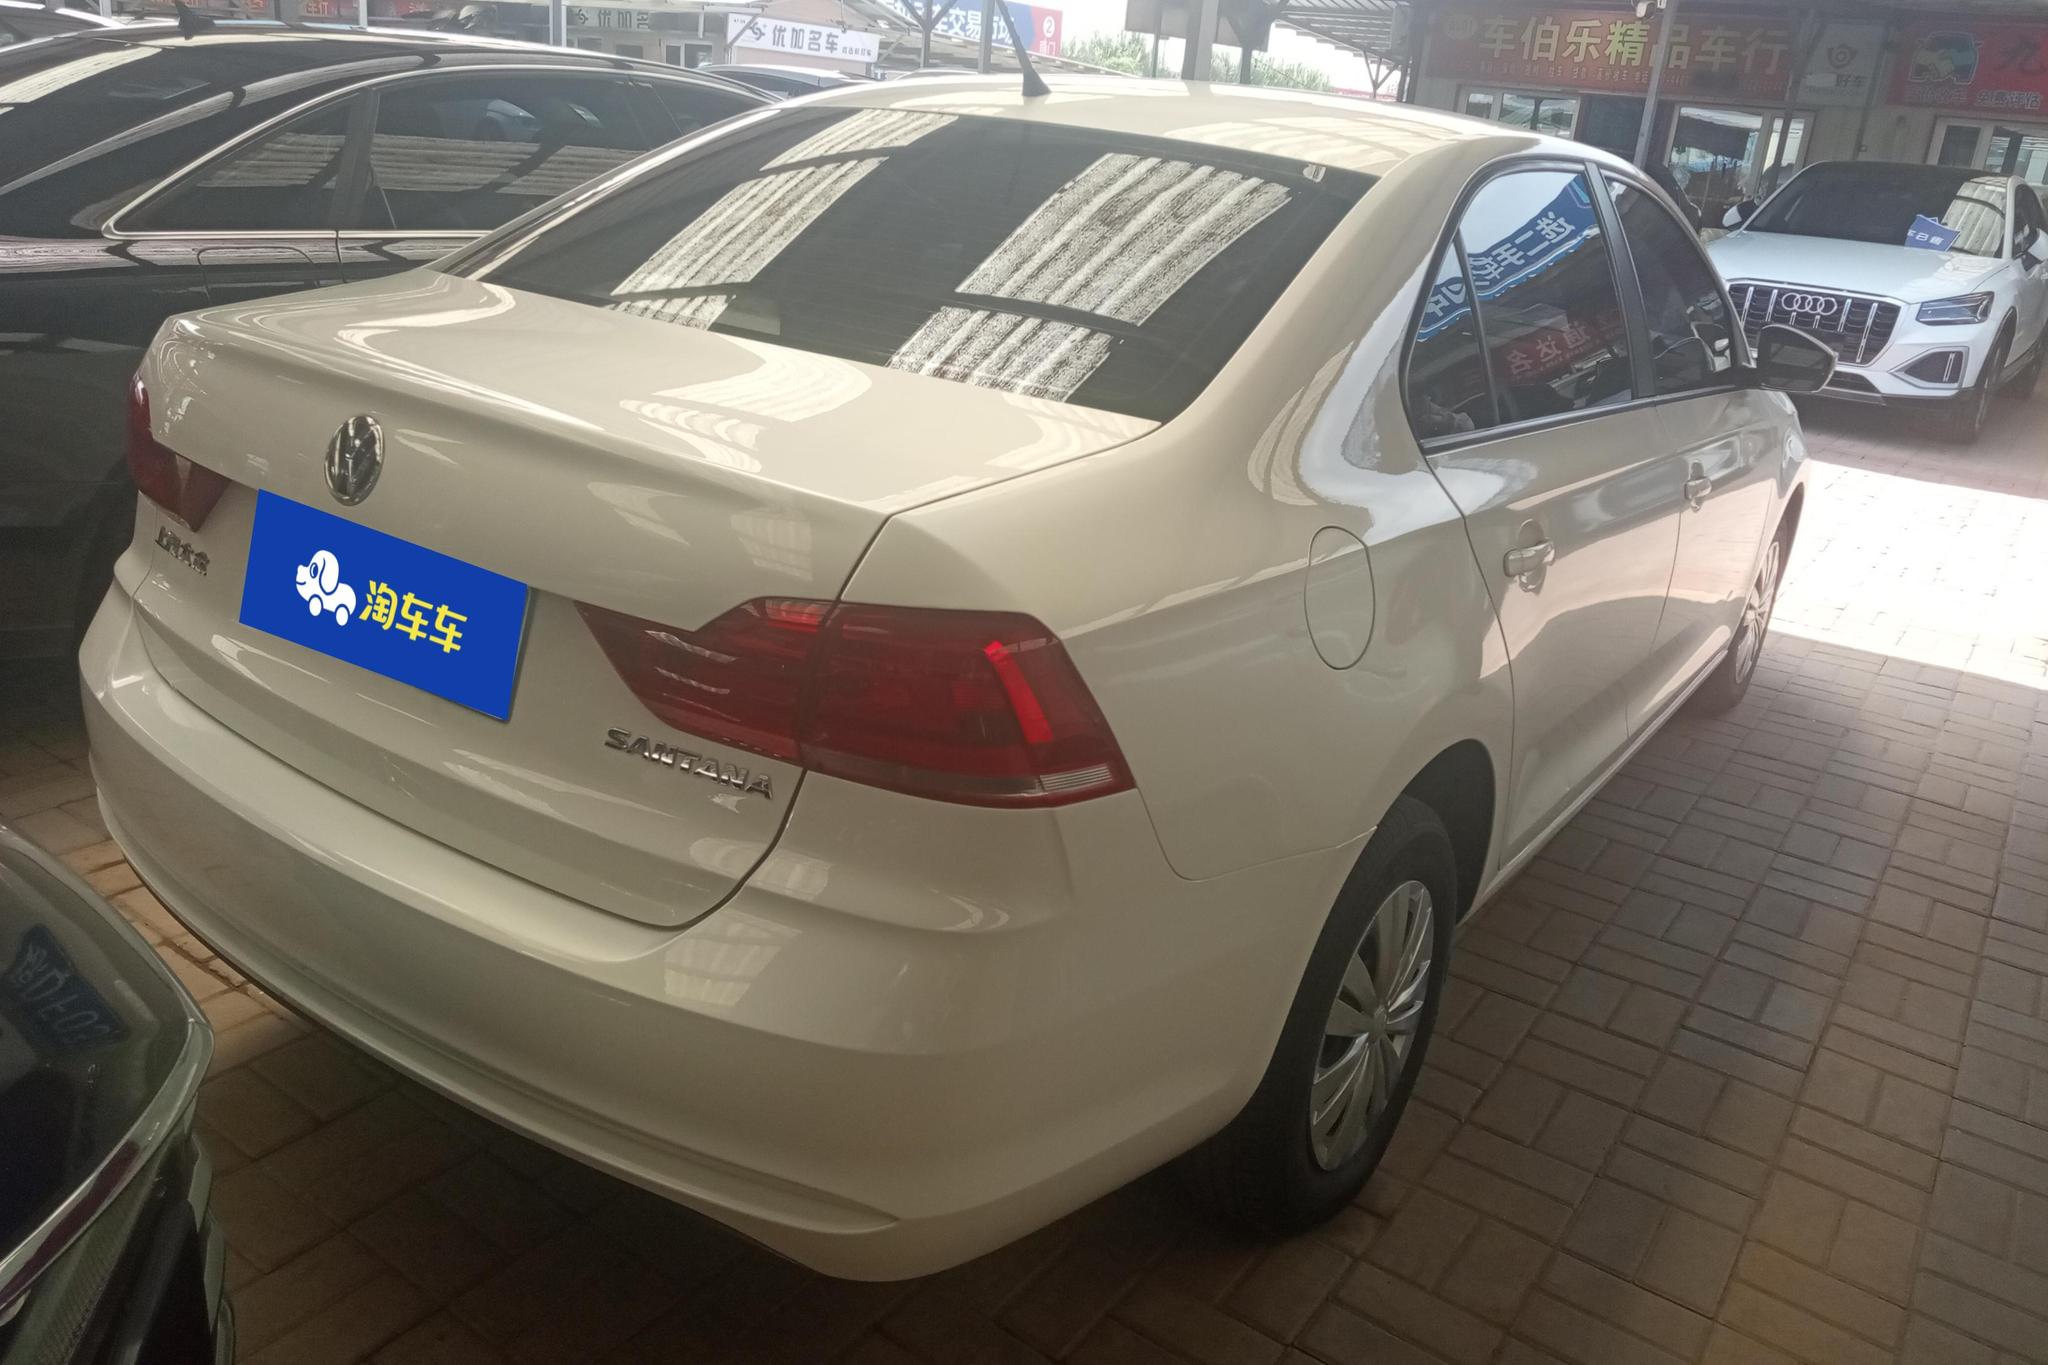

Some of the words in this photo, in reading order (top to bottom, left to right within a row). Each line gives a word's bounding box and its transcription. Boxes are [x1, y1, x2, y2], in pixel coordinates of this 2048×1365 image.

[772, 24, 839, 54] 优加名车
[1479, 14, 1789, 75] 车伯乐精品车行
[604, 726, 774, 800] SANTANA
